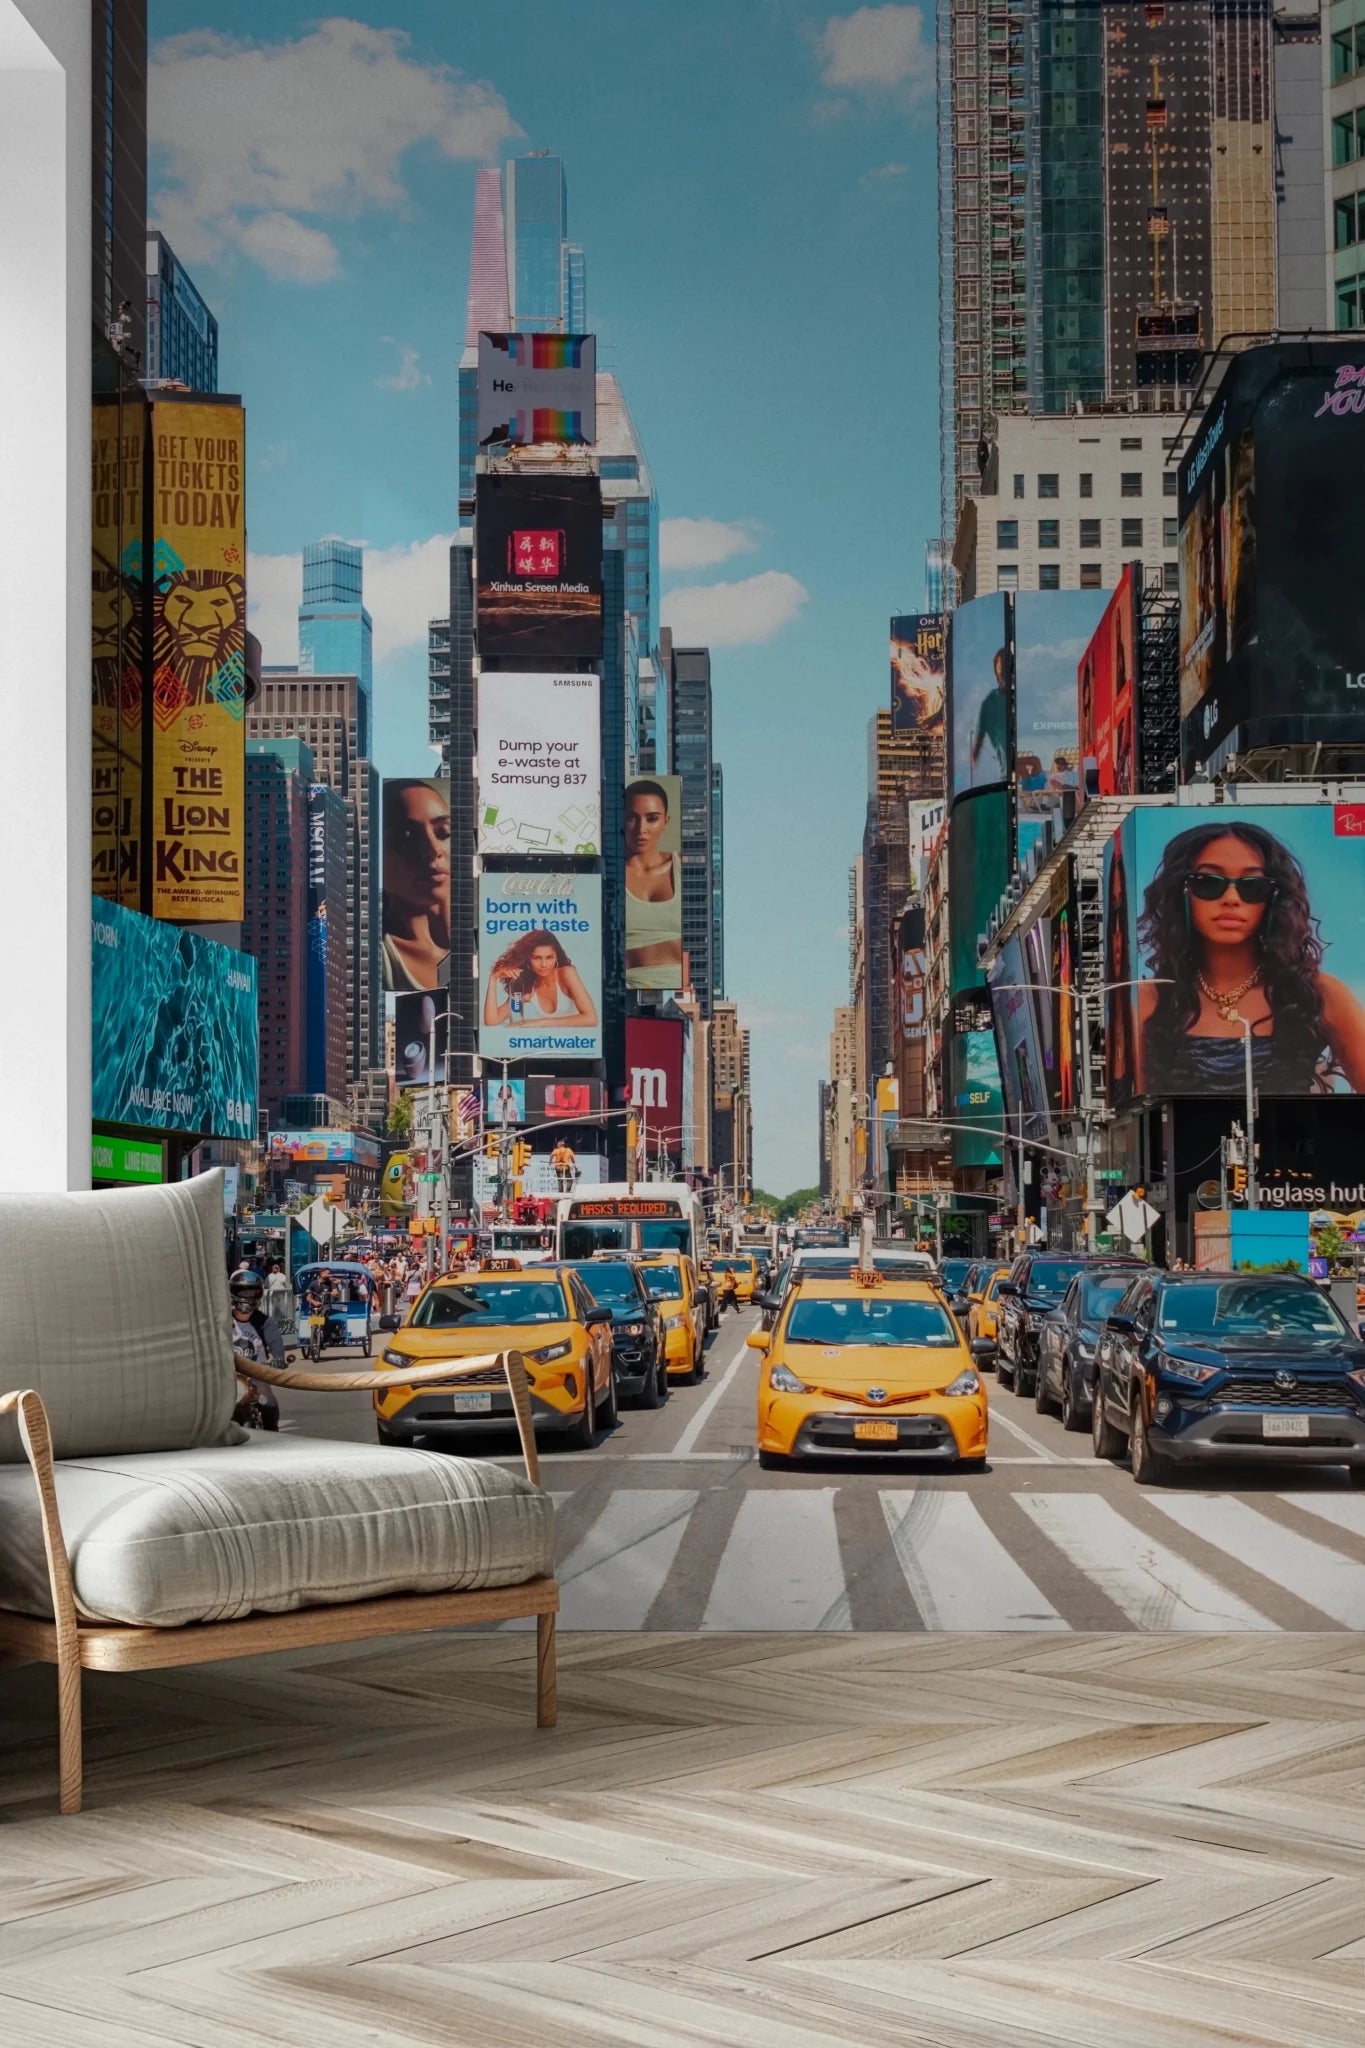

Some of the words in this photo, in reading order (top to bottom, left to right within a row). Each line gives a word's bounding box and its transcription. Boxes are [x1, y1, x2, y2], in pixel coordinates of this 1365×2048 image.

[158, 435, 187, 460] GET
[194, 437, 238, 462] YOUR
[158, 460, 240, 492] TICKETS
[158, 489, 240, 529] TODAY
[490, 581, 523, 593] Xinhua
[525, 581, 558, 593] Screen
[560, 582, 589, 593] Media
[917, 632, 942, 656] Har
[499, 739, 542, 755] Dump
[546, 741, 579, 755] your
[498, 758, 560, 769] e-waste
[564, 758, 580, 769] at
[173, 766, 223, 789] THE
[491, 773, 560, 788] Samsung
[563, 774, 587, 785] 837
[163, 798, 230, 836] LION
[921, 806, 944, 831] LIT
[156, 840, 239, 883] KING
[157, 887, 171, 895] THE
[173, 888, 240, 897] AWARD-WINNING
[171, 895, 189, 903] BEST
[190, 896, 224, 904] MUSICAL
[486, 898, 531, 914] born
[536, 899, 578, 914] with
[486, 917, 537, 935] great
[542, 918, 589, 933] taste
[509, 1036, 597, 1048] smartwater
[130, 1085, 172, 1112] AVAILABLE
[172, 1091, 194, 1115] NOW
[969, 1092, 990, 1104] SELF
[1331, 1182, 1365, 1203] hut
[581, 1204, 614, 1215] MASKS
[617, 1203, 667, 1215] REQUIRED
[490, 1260, 509, 1270] 3C17
[857, 1273, 879, 1285] 2072
